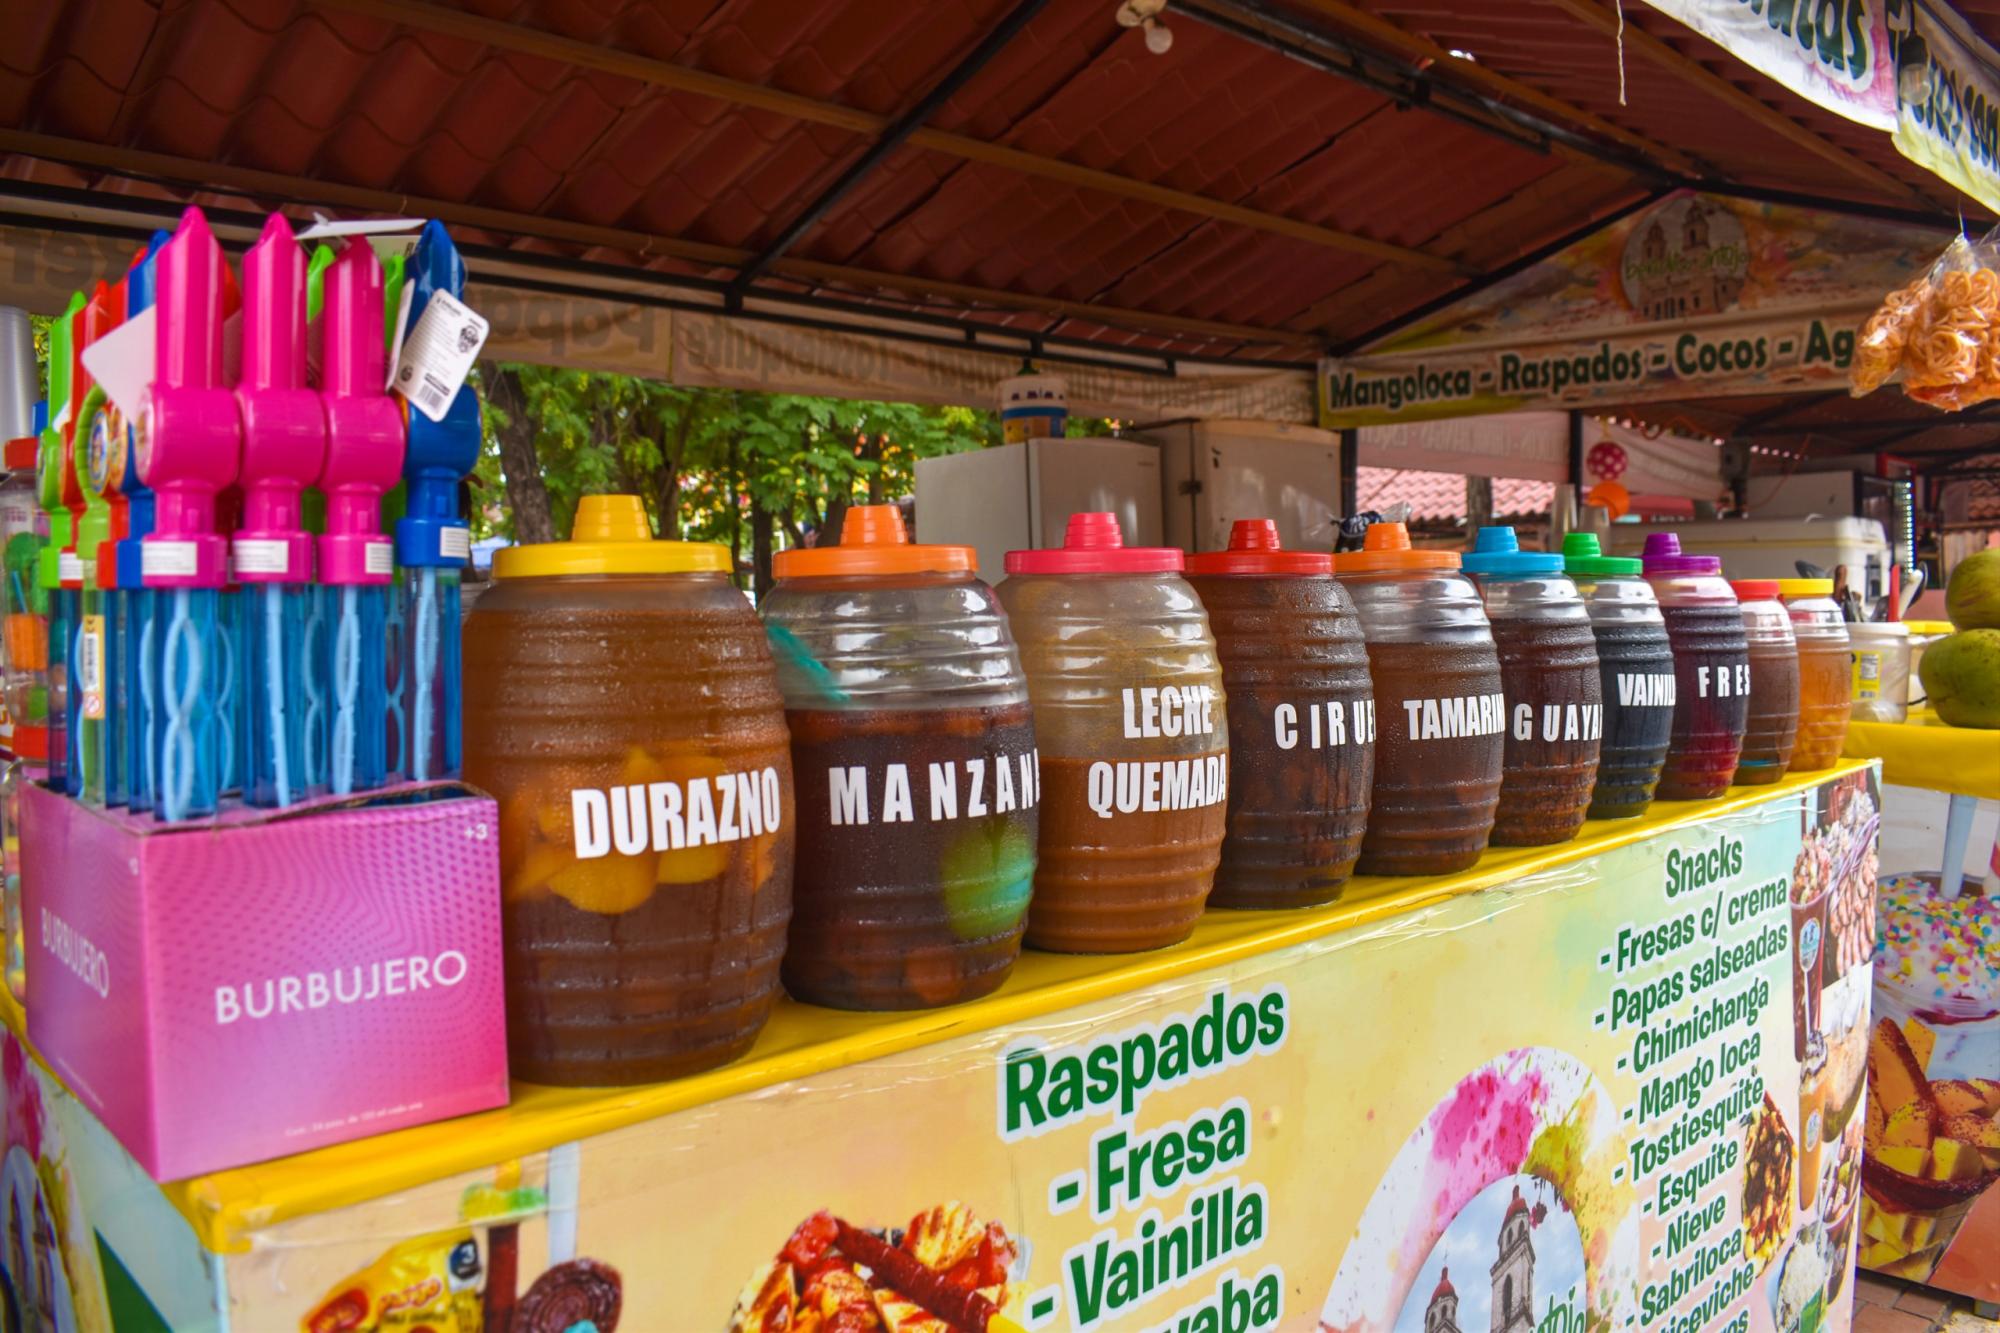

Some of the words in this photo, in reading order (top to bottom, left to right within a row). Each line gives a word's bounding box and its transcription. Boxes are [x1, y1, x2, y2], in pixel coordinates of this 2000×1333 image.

[1330, 364, 1471, 409] Mangoloca
[1501, 335, 1642, 394] Raspados
[1676, 334, 1766, 376] Cocos
[1122, 685, 1213, 739] LECHE
[1513, 703, 1603, 742] GUAYA
[465, 823, 488, 840] +3
[571, 766, 780, 859] DURAZNO
[1088, 753, 1226, 818] QUEMADA
[1666, 835, 1742, 898] Snacks
[41, 906, 109, 999] BURBUJERO
[1617, 913, 1695, 973] Fresas
[1701, 890, 1723, 939] c/
[1728, 878, 1787, 925] crema
[215, 950, 467, 1024] BURBUJERO
[1612, 971, 1683, 1031] Papas
[1689, 924, 1788, 994] salseadas
[1006, 991, 1285, 1133] Raspados
[1634, 977, 1769, 1073] Chimichanga
[1639, 1056, 1714, 1125] Mango
[1720, 1032, 1760, 1077] loca
[1098, 1106, 1246, 1214] Fresa
[1631, 1076, 1764, 1181] Tostiesquite
[1659, 1140, 1738, 1216] Esquite
[1070, 1186, 1262, 1326] Vainilla
[1667, 1195, 1726, 1259] Nieve
[1641, 1228, 1742, 1327] Sabriloca
[1660, 1262, 1755, 1333] iceviche
